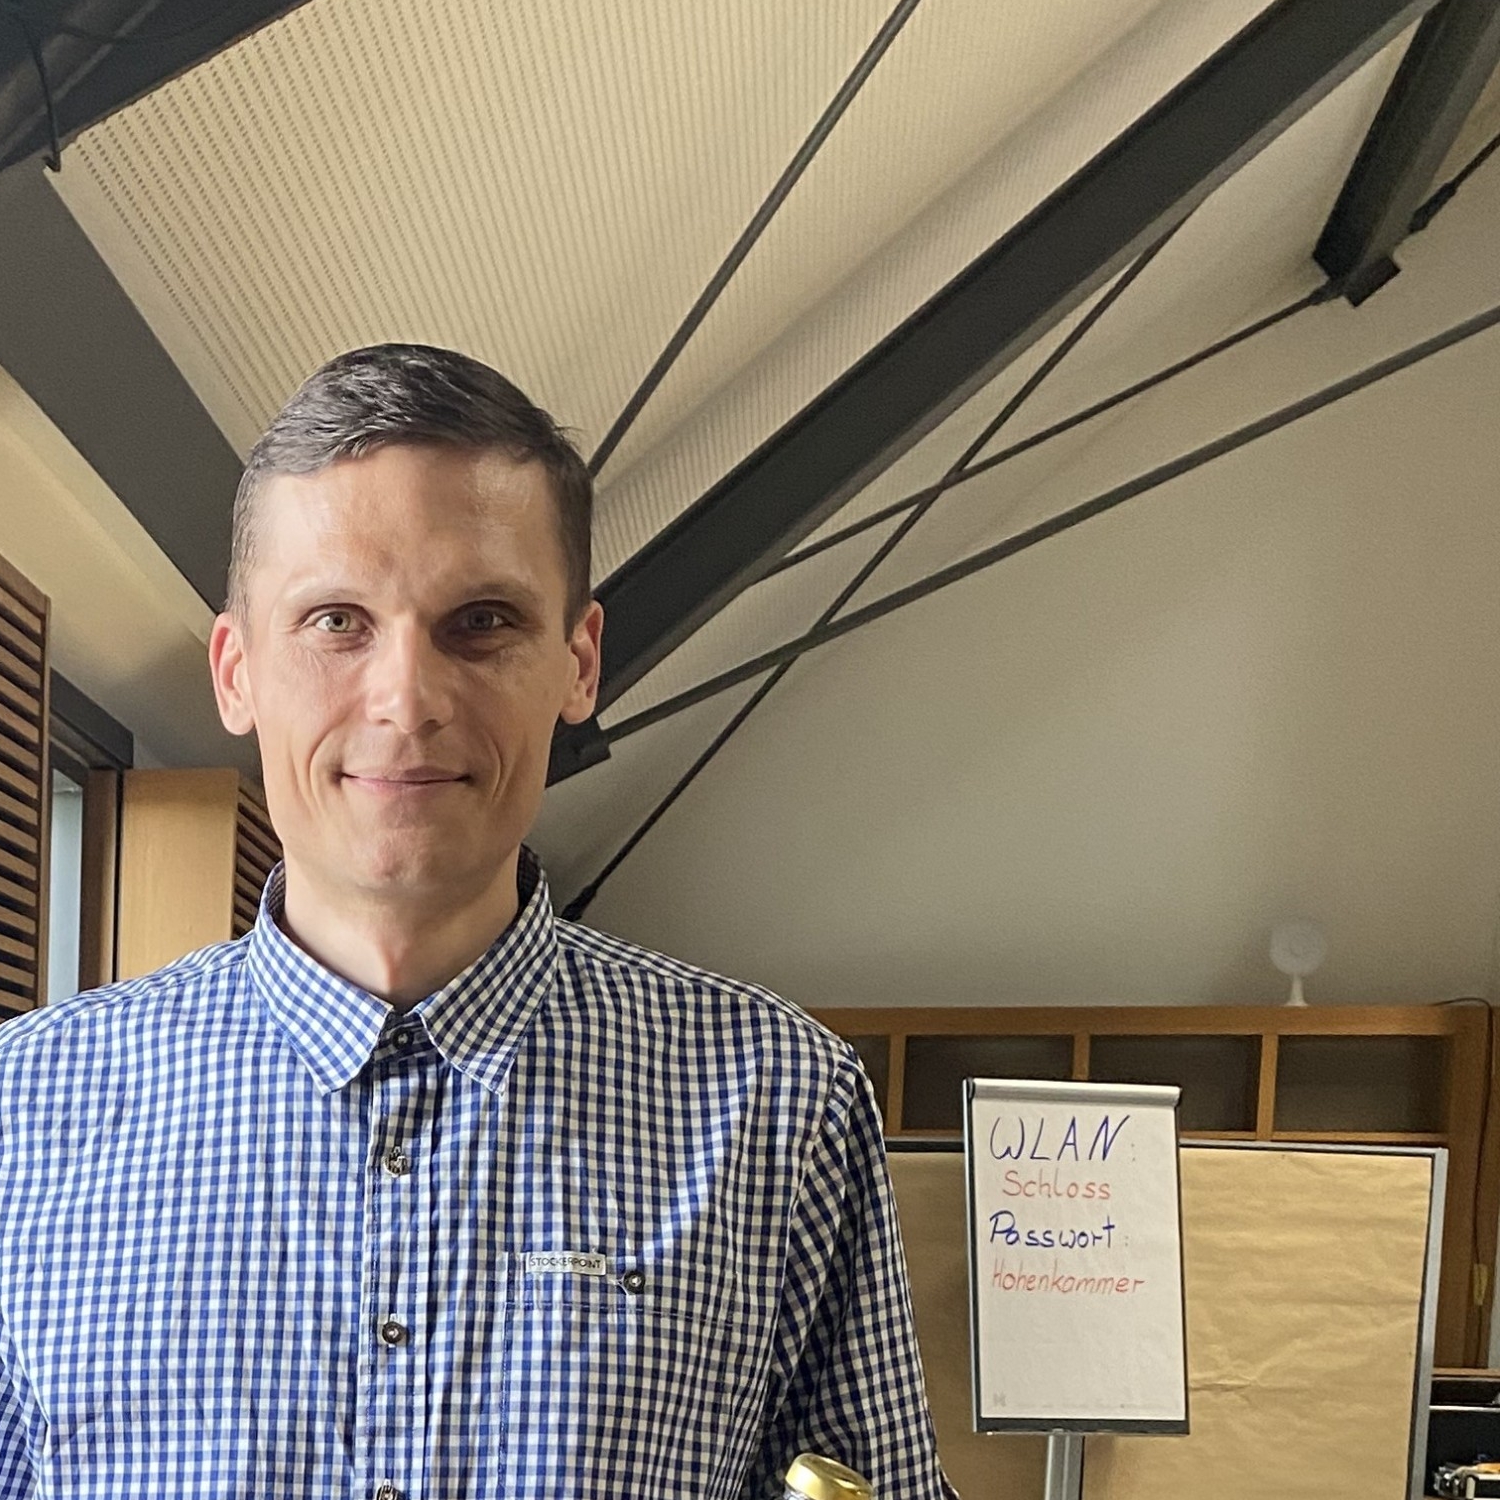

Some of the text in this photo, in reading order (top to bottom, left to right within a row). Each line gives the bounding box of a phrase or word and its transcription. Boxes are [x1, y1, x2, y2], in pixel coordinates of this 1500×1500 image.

[1002, 1167, 1112, 1200] Schloss
[528, 1257, 601, 1270] STOCKERPOINT
[993, 1258, 1146, 1295] Hohenkammer
